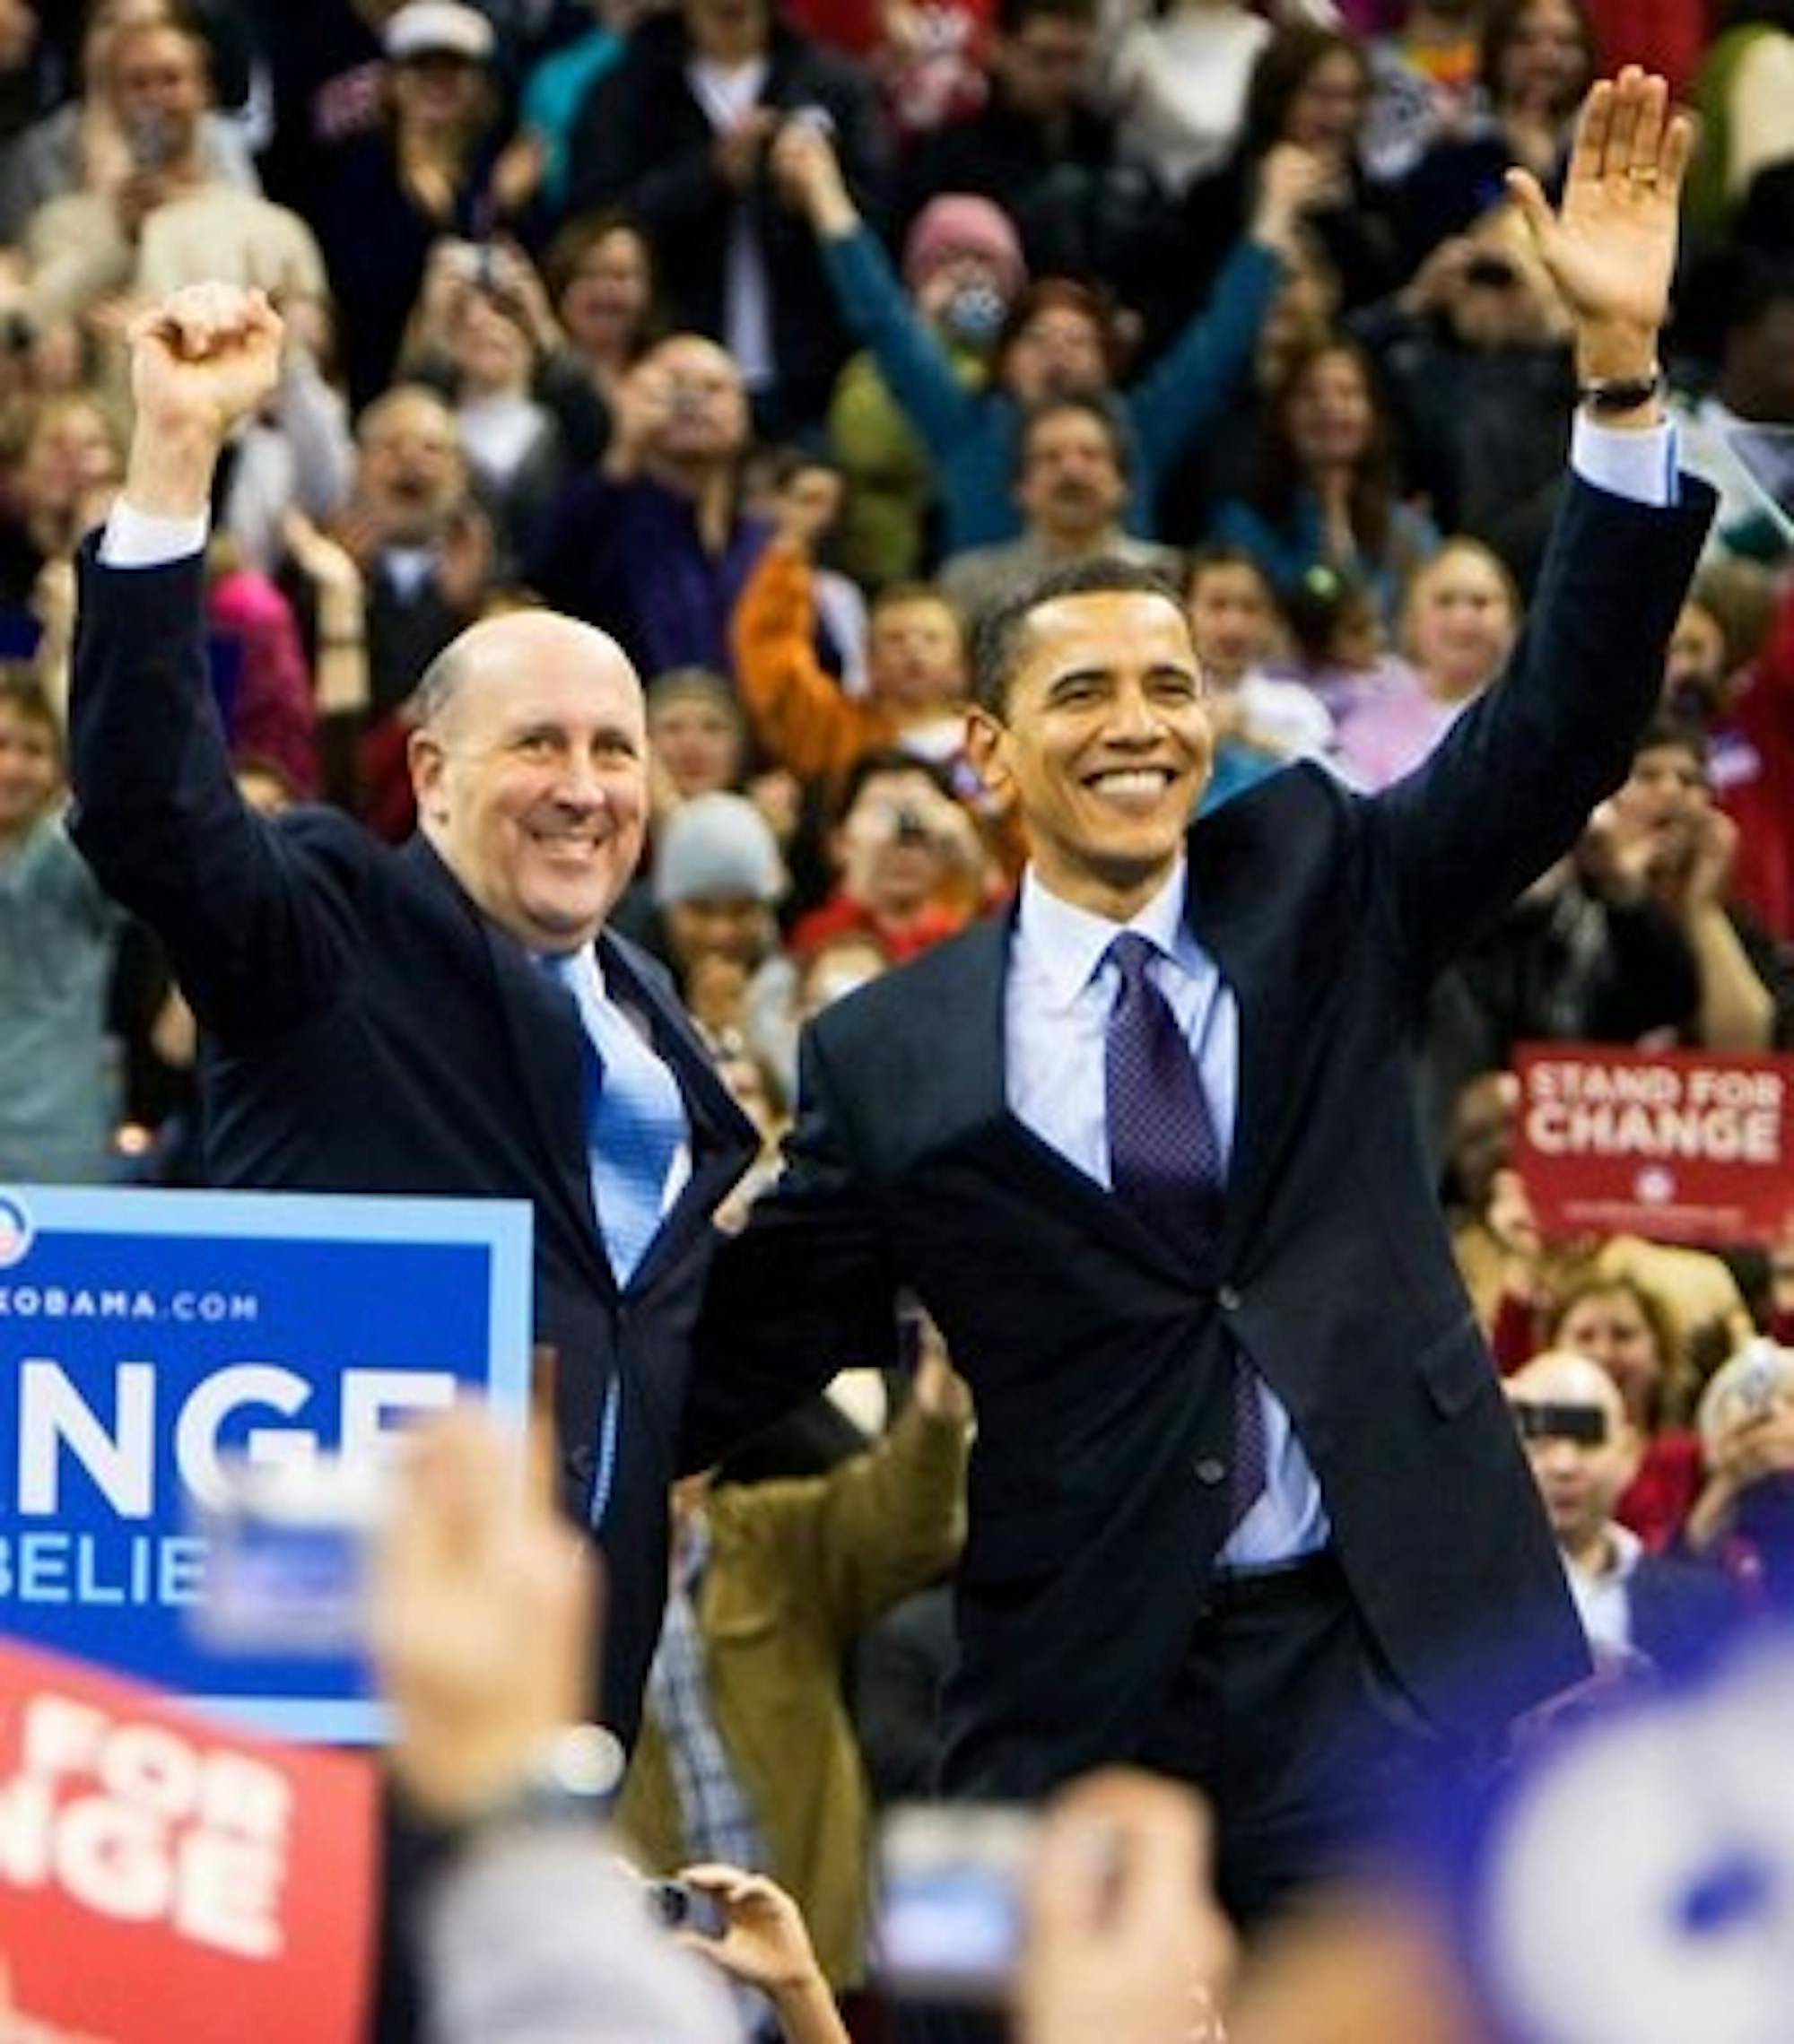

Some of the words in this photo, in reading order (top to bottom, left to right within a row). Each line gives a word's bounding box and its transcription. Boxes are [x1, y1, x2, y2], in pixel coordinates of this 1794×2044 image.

[1529, 1061, 1681, 1104] STAND
[1689, 1069, 1784, 1109] FOR
[1527, 1102, 1782, 1162] CHANGE
[0, 1530, 208, 1605] ELIE
[24, 1693, 291, 1844] FOR
